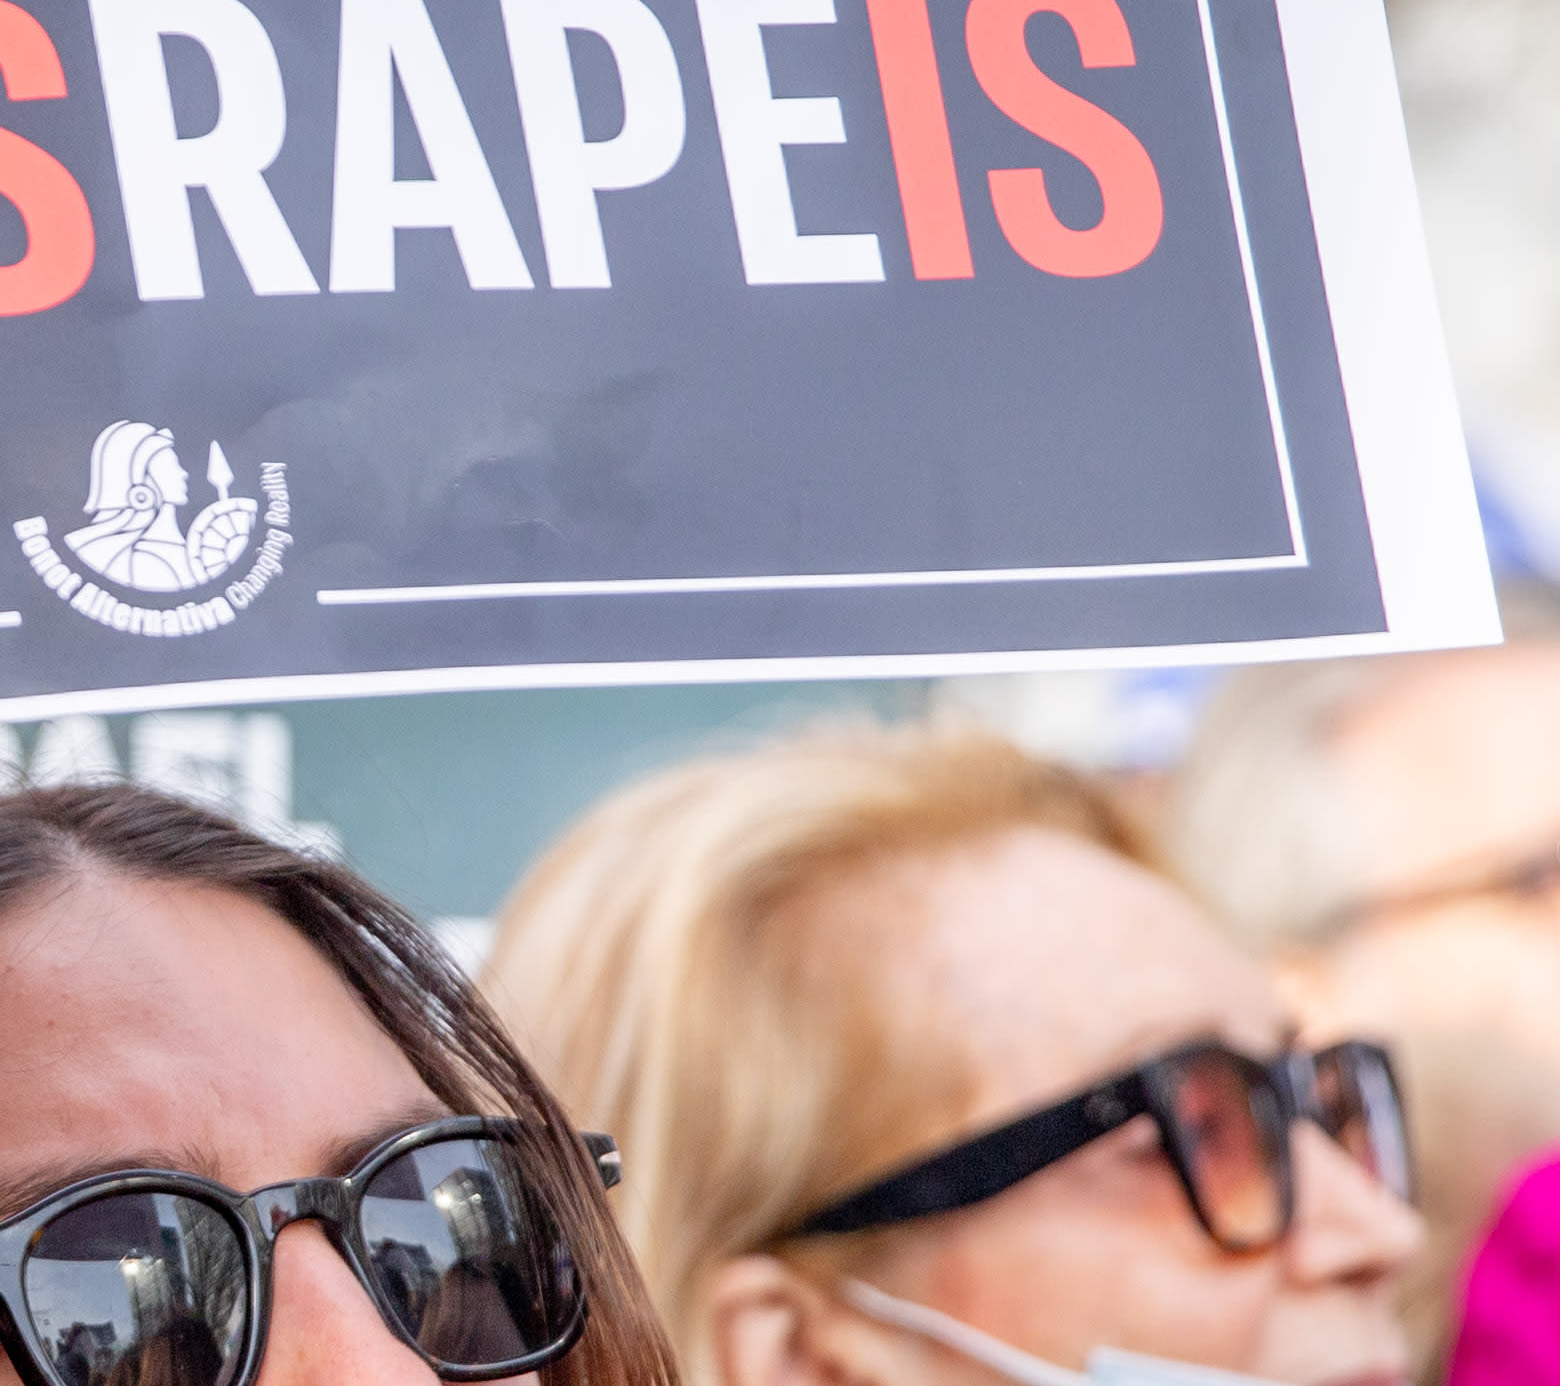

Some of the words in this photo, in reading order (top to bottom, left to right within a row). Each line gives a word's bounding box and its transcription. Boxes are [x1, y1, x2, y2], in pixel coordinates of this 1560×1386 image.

[13, 515, 82, 599] Bonot
[70, 581, 236, 637] Alternativa
[225, 527, 294, 610] Changing
[260, 461, 291, 527] Reality
